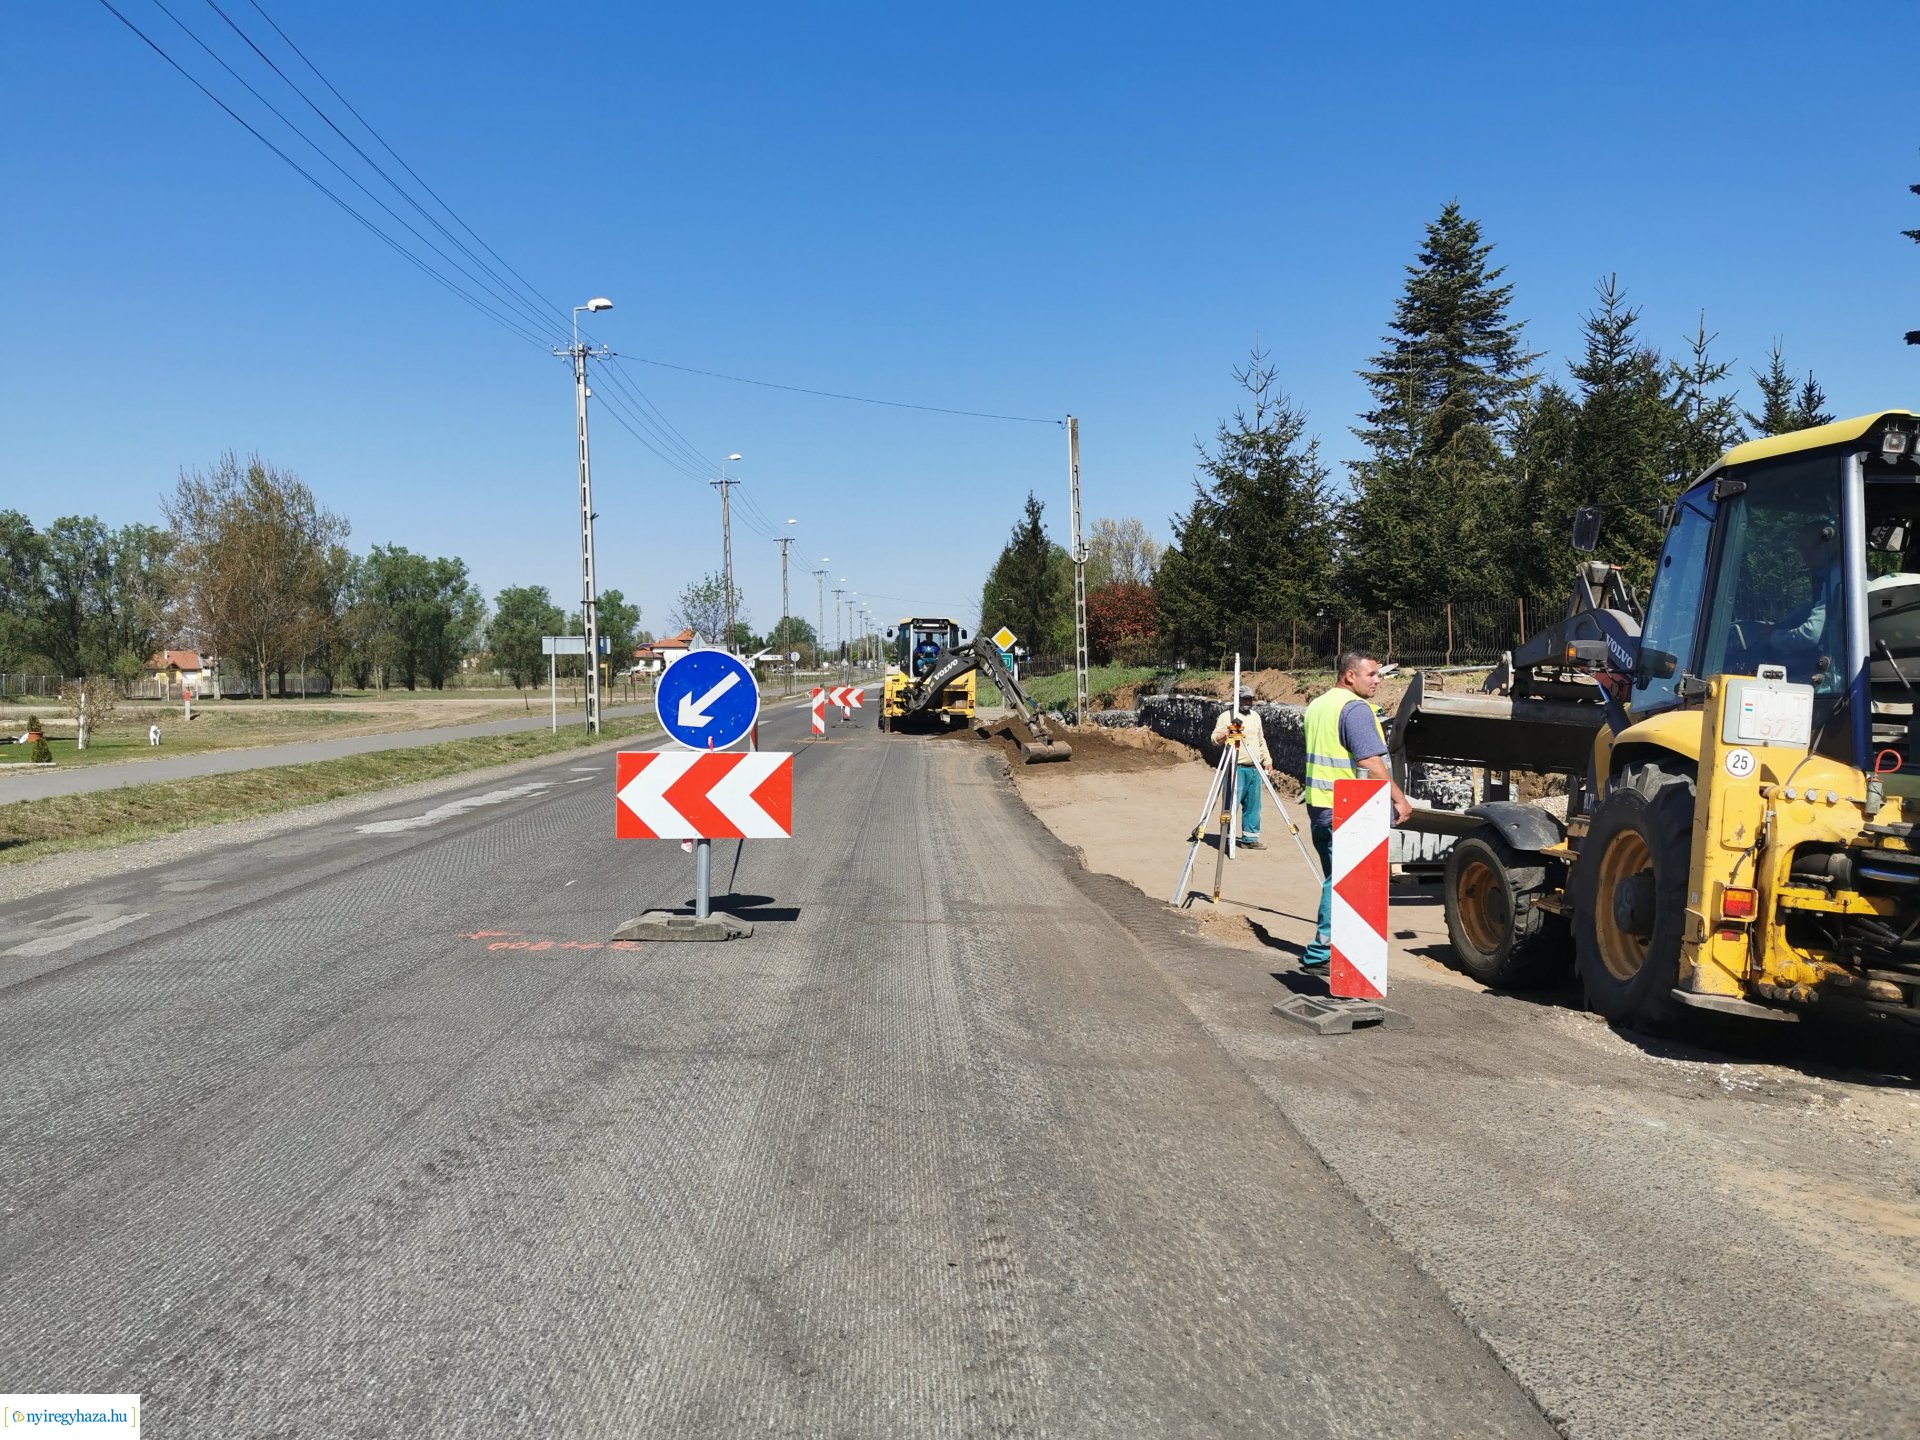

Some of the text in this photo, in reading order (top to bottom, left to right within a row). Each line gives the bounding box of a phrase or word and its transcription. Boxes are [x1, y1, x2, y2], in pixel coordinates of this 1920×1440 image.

[1606, 633, 1633, 669] VOLVO
[934, 659, 958, 680] VOLVO
[1732, 754, 1749, 770] 25
